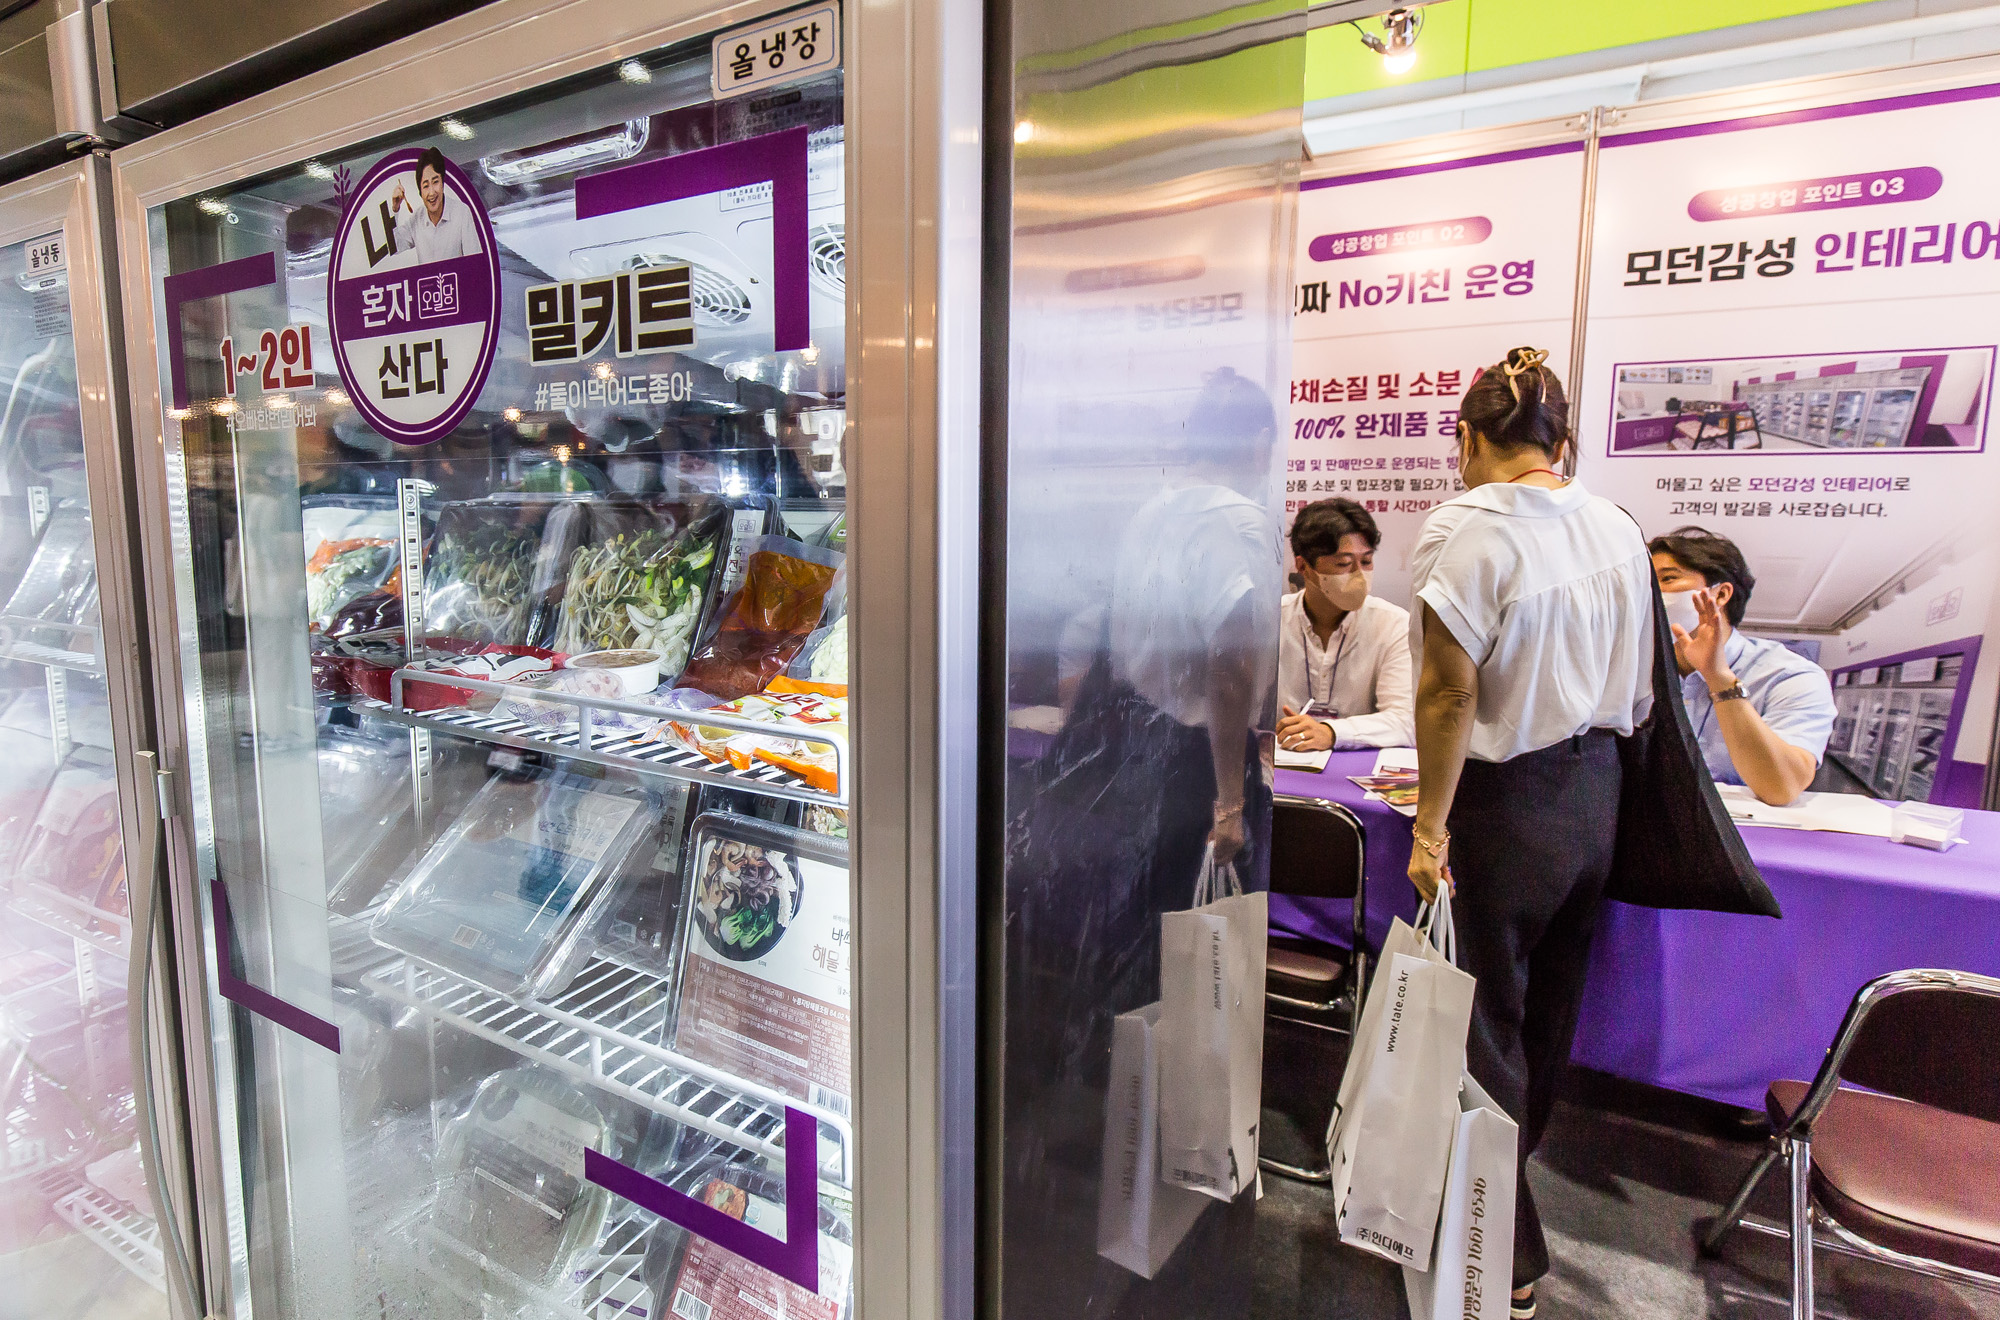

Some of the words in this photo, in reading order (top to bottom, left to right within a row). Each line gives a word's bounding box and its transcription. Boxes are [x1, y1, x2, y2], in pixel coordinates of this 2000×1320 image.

[729, 22, 821, 81] 올냉장
[1719, 187, 1797, 214] 성공창업
[1802, 180, 1863, 204] 포인트
[1869, 176, 1906, 198] 03
[360, 199, 398, 269] 나
[1331, 234, 1388, 255] 성공창업
[1391, 228, 1434, 247] 포인트
[1440, 224, 1465, 241] 02
[1622, 235, 1798, 288] 모던감성
[1814, 219, 2000, 274] 인테리어
[31, 242, 60, 269] 올냉동
[361, 284, 413, 329] 혼자
[421, 283, 457, 314] 오밀당
[1293, 281, 1332, 319] 짜
[1339, 267, 1450, 310] No키친
[1463, 258, 1536, 300] 운영
[527, 265, 695, 364] 밀키트
[219, 324, 316, 398] 1~2인
[378, 337, 450, 401] 산다
[534, 370, 694, 412] #둘이먹어도좋아
[1377, 372, 1401, 400] 및
[1409, 369, 1462, 397] 소분
[1294, 413, 1346, 441] 100%
[1354, 411, 1430, 441] 완제품
[1310, 458, 1322, 472] 및
[1325, 457, 1387, 472] 판매만으로
[1391, 456, 1442, 471] 운영되는
[1311, 479, 1337, 493] 소분
[1340, 479, 1352, 492] 및
[1356, 478, 1406, 492] 합포장할
[1409, 478, 1448, 492] 필요가
[1656, 477, 1704, 493] 머물고
[1709, 477, 1742, 493] 싶은
[1747, 477, 1816, 493] 모던감성
[1822, 476, 1912, 493] 인테리어로
[1394, 500, 1431, 513] 시간이
[1669, 501, 1718, 517] 고객의
[1723, 501, 1773, 517] 발길을
[1778, 501, 1889, 518] 사로잡습니다.
[812, 943, 840, 974] 해물
[1386, 969, 1410, 1054] www.tate.co.kr
[1467, 1177, 1488, 1262] 1661-6546
